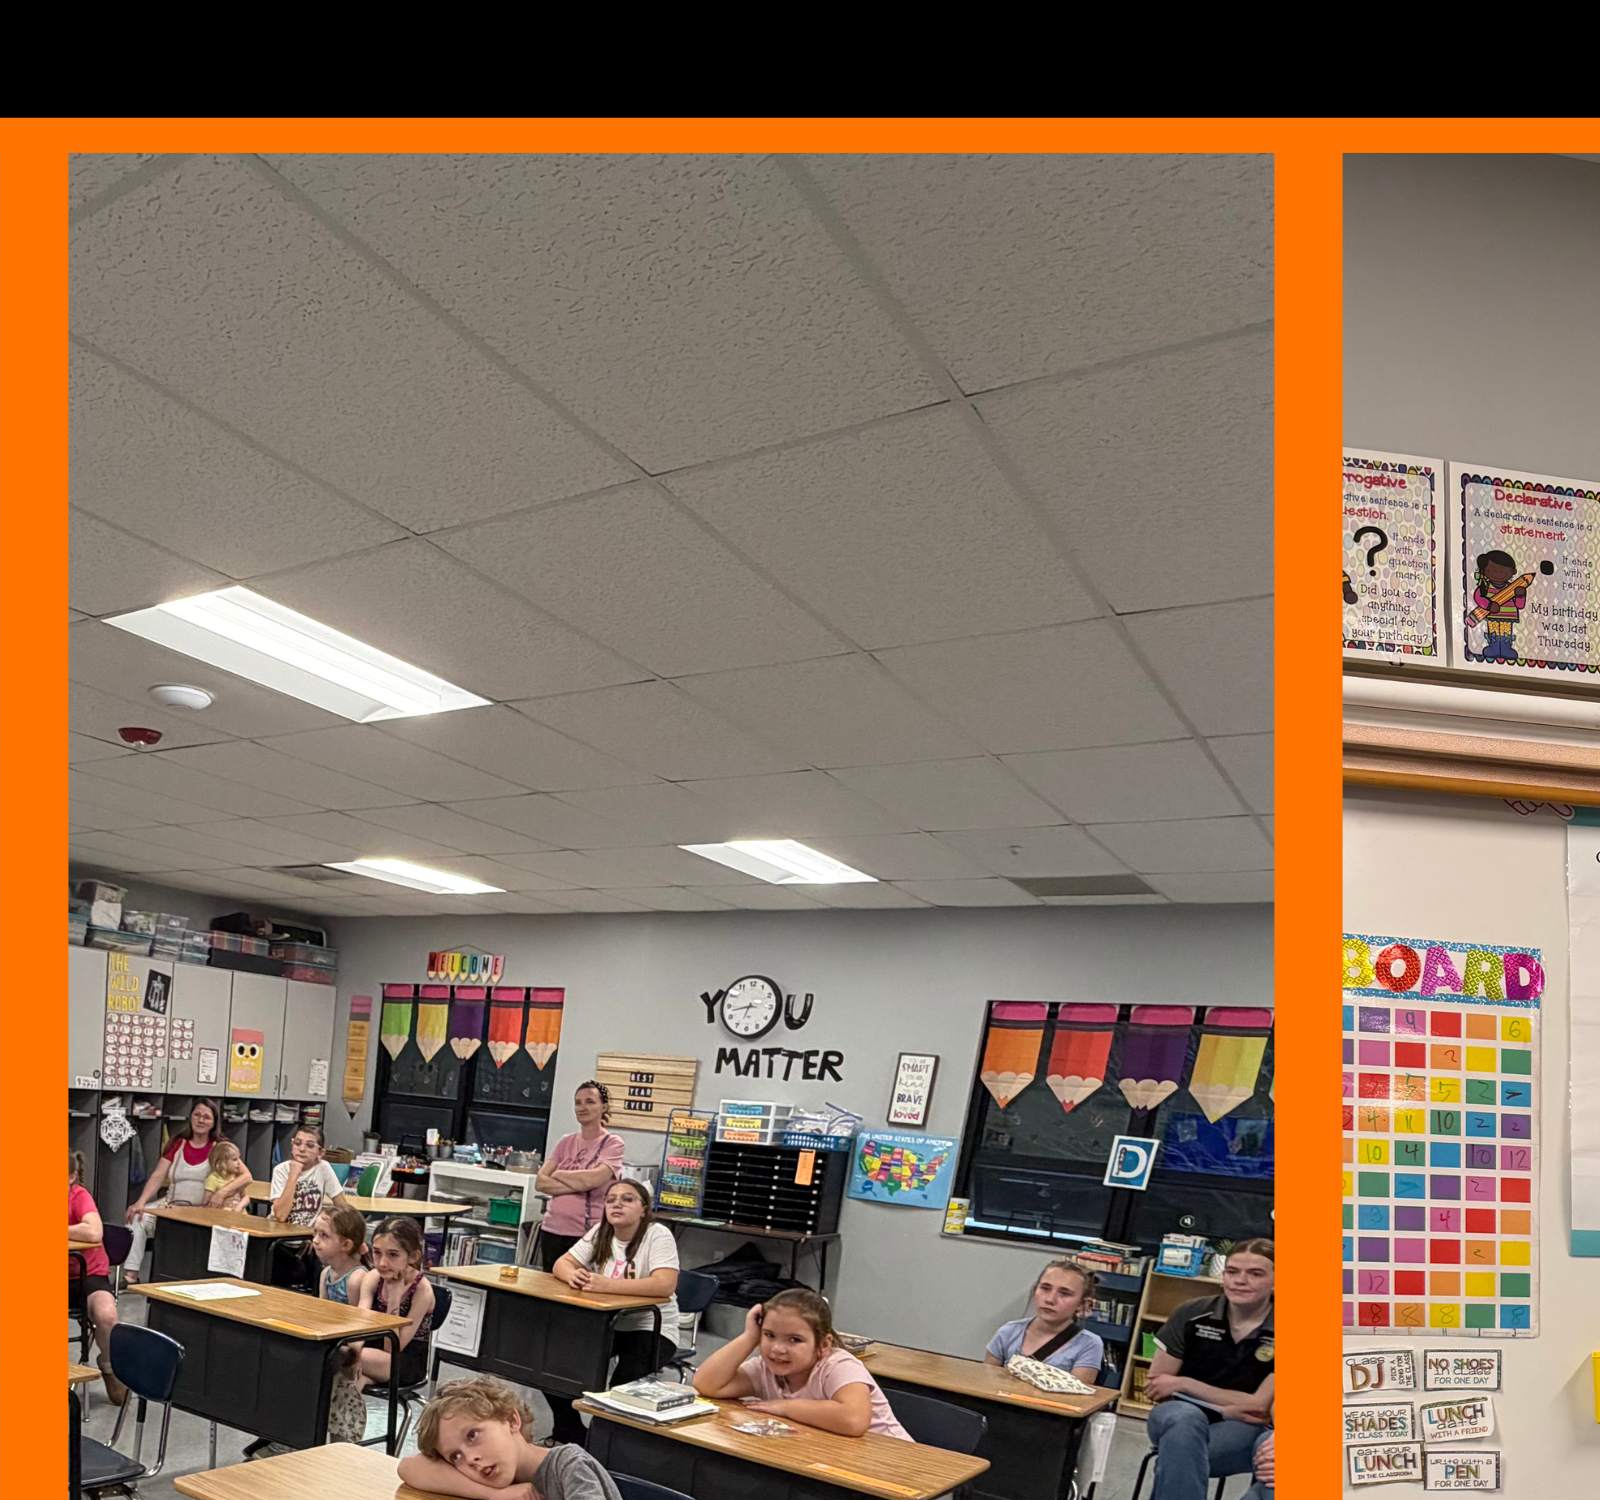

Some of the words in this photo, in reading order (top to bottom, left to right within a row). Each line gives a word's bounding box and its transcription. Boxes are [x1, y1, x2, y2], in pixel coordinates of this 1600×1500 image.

[1494, 488, 1573, 512] Declarative
[1552, 605, 1598, 621] birthday
[715, 1048, 843, 1082] MATTER
[1429, 1359, 1448, 1369] NO
[1453, 1359, 1495, 1370] SHOES
[1444, 1465, 1480, 1479] PEN
